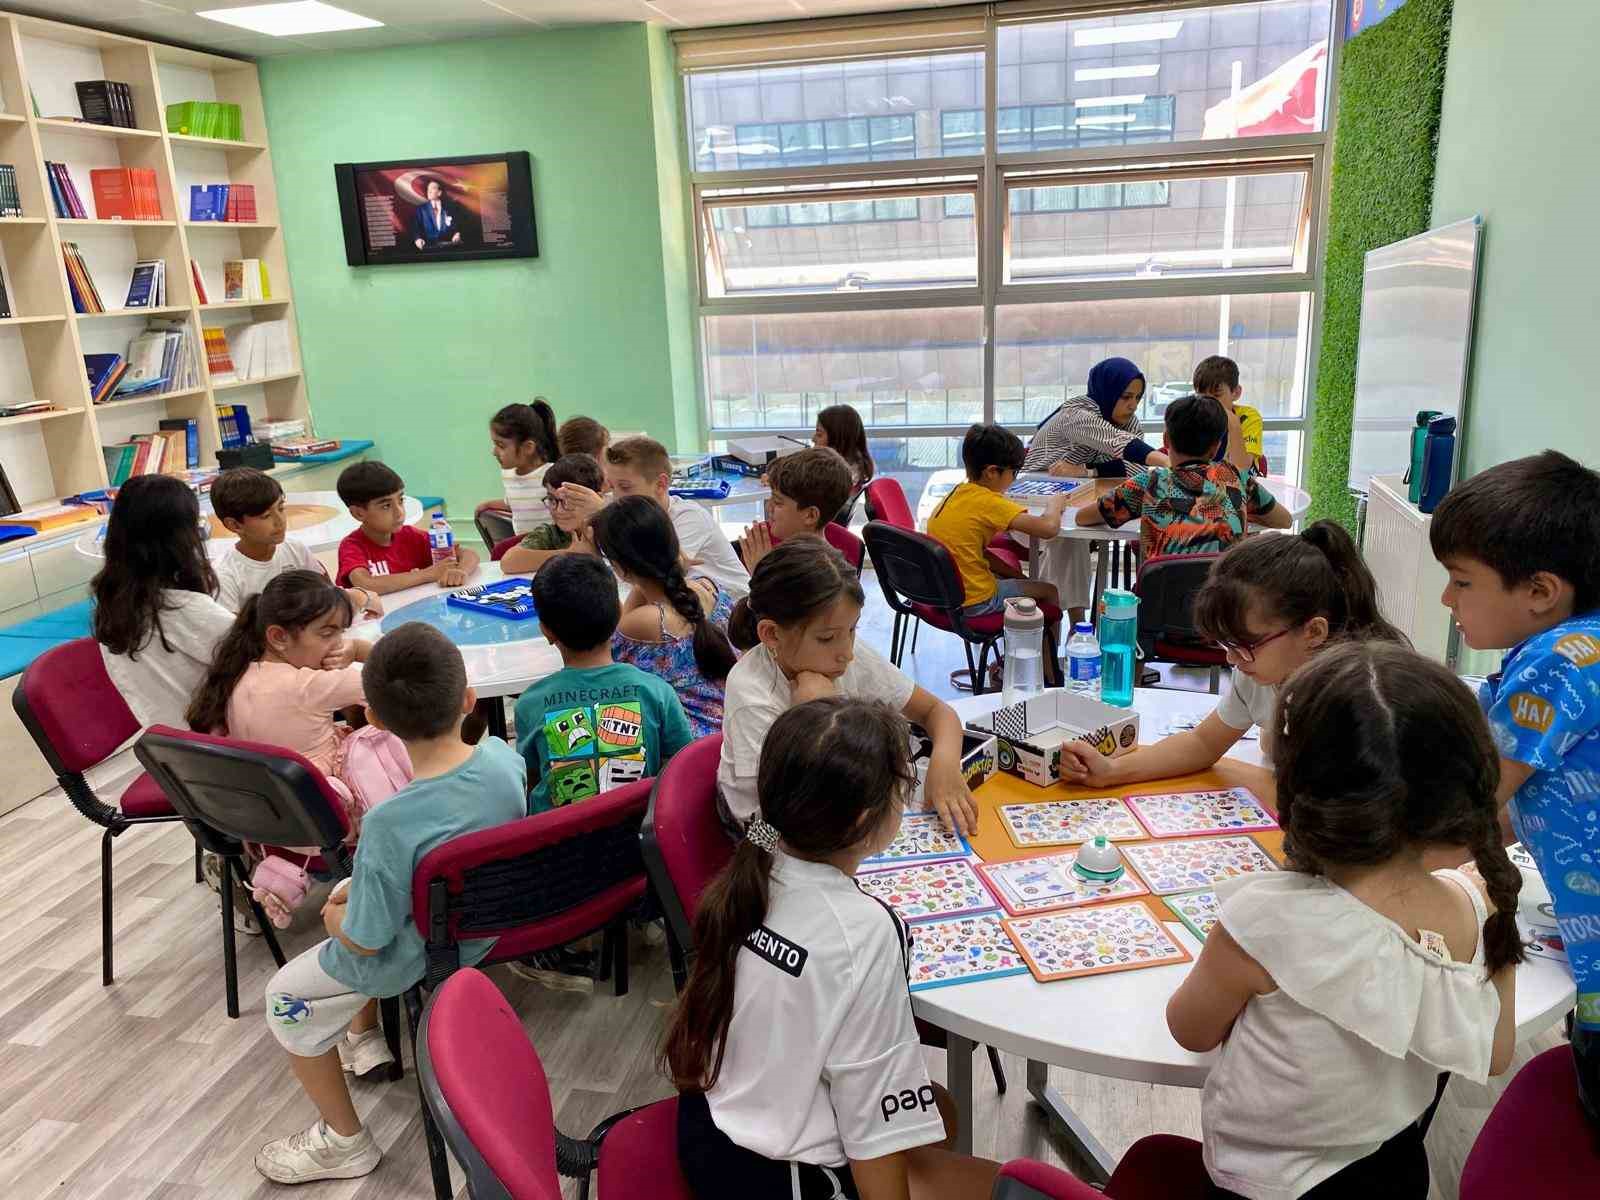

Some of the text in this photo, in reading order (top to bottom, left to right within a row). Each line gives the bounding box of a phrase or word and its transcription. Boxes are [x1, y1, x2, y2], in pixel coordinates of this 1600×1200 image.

[544, 684, 640, 706] MINECRAFT
[1515, 695, 1551, 726] HA!
[613, 718, 639, 736] TNT
